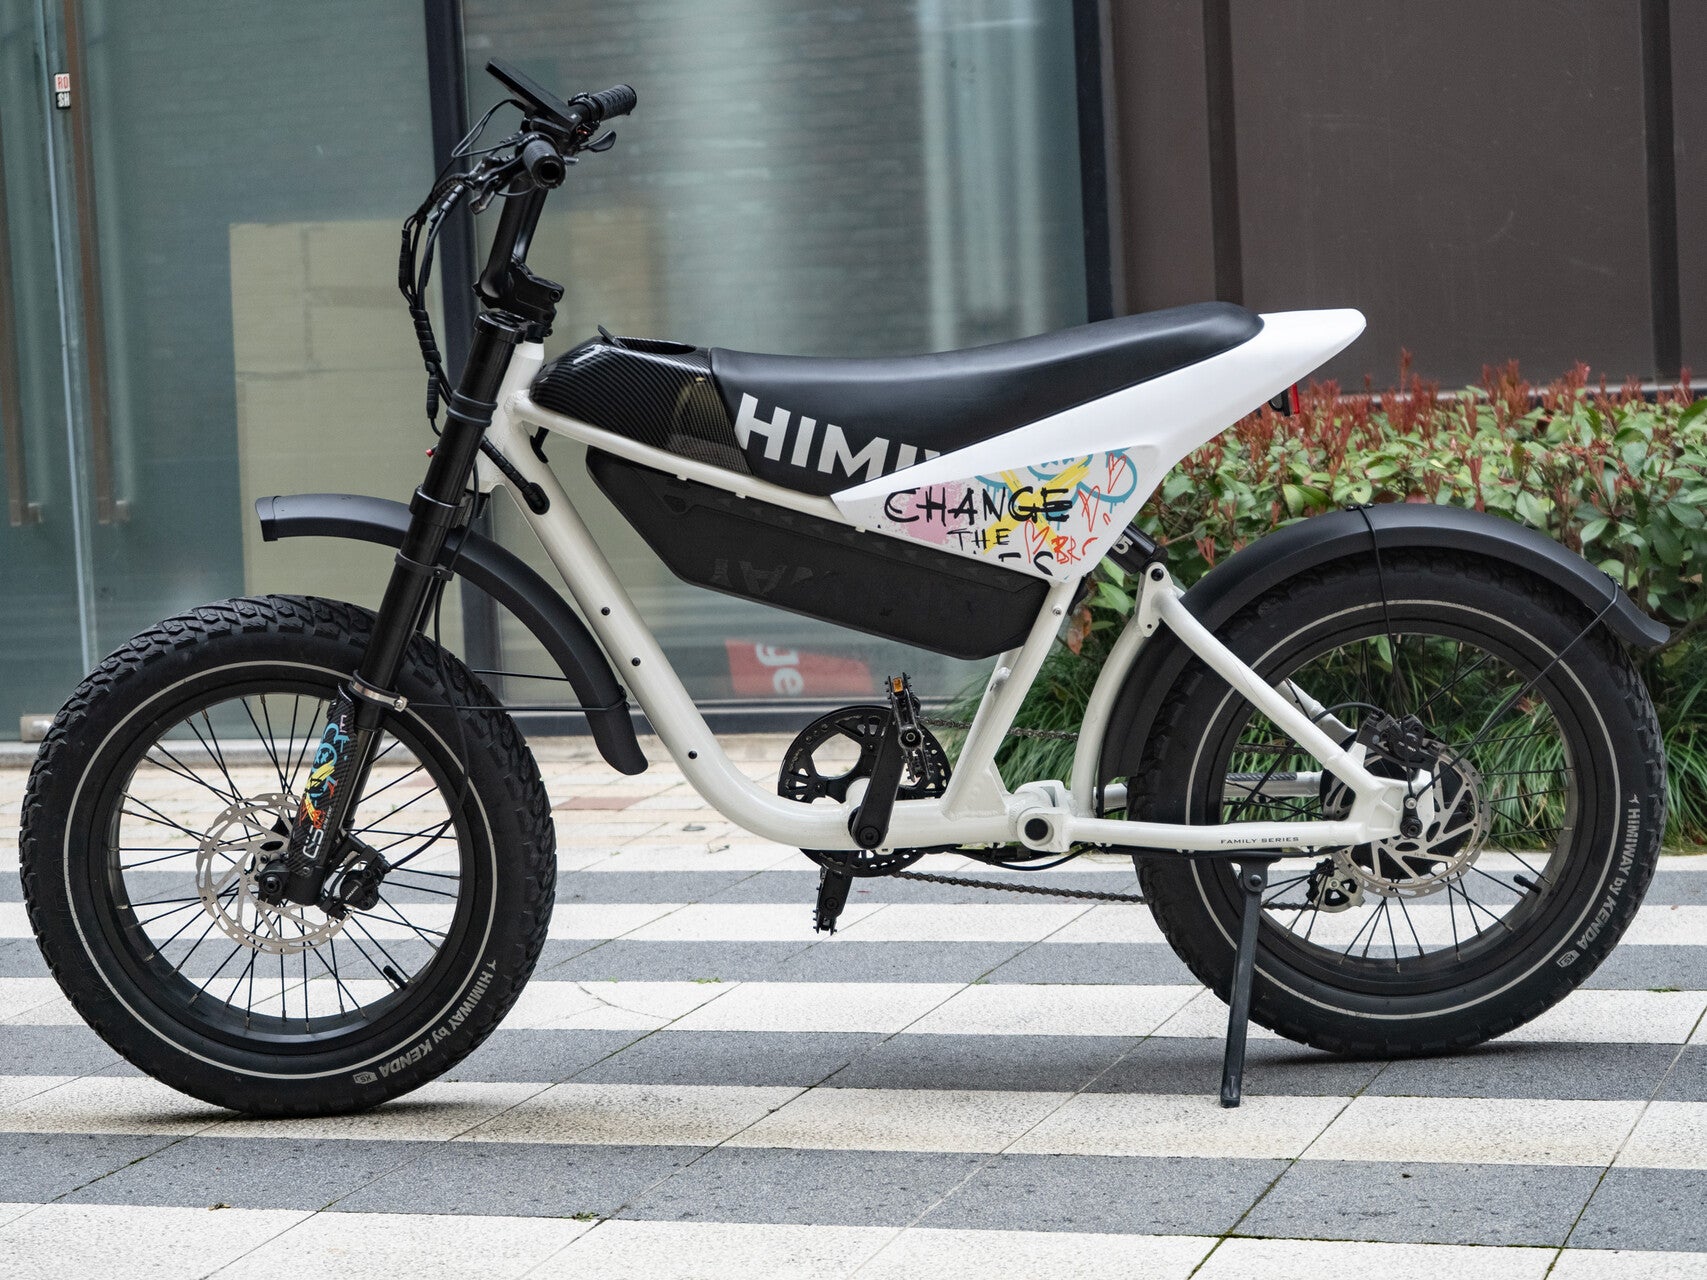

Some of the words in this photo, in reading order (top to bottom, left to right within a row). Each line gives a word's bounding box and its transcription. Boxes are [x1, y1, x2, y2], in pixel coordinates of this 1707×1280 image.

[734, 392, 940, 482] HIMI
[884, 486, 1073, 526] CHANGE
[947, 527, 1011, 551] THE
[1618, 808, 1641, 876] HIMIWAY
[1608, 877, 1629, 896] by
[1576, 895, 1617, 950] KENDA
[447, 970, 494, 1031] HIMIWAY
[431, 1026, 452, 1044] by
[378, 1038, 433, 1078] KENDA
